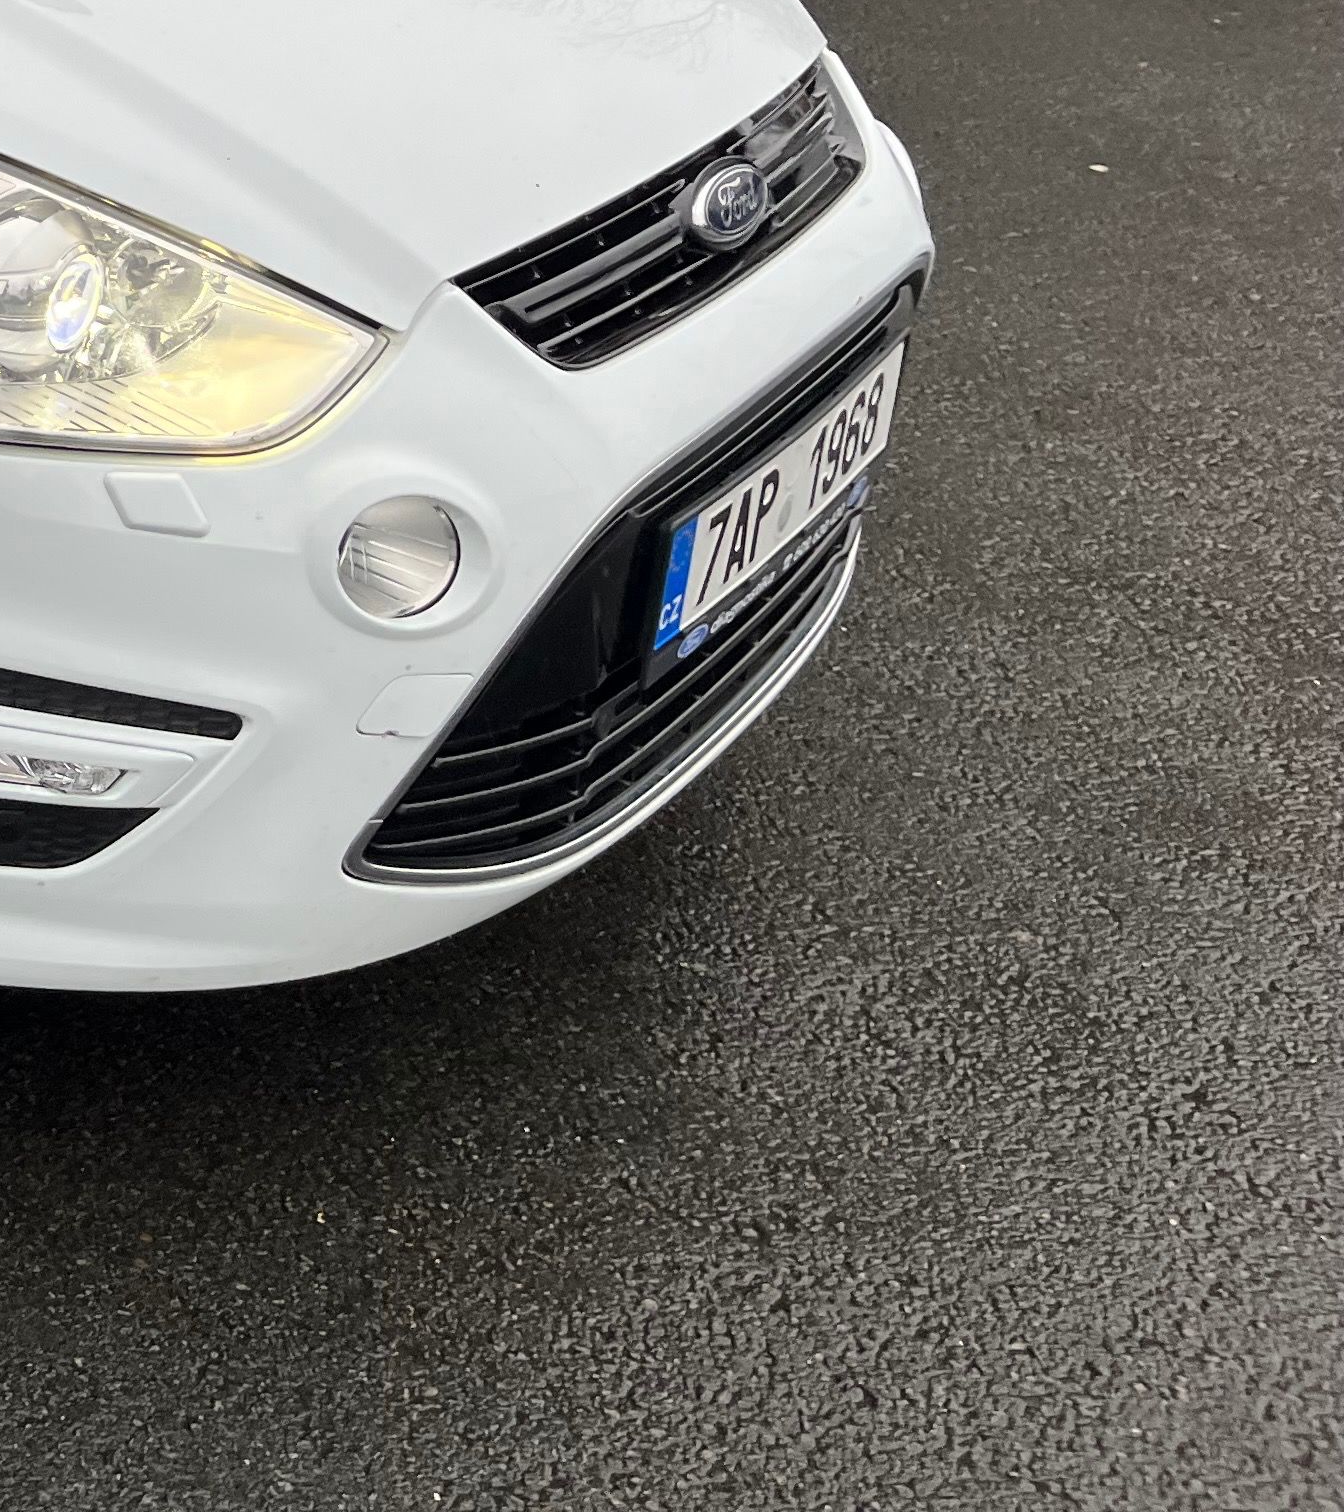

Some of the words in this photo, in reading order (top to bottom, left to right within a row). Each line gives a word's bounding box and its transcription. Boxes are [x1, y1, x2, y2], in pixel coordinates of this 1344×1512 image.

[717, 176, 758, 228] Ford
[696, 468, 780, 607] 7AP
[808, 372, 884, 511] 1968
[659, 593, 683, 631] CZ
